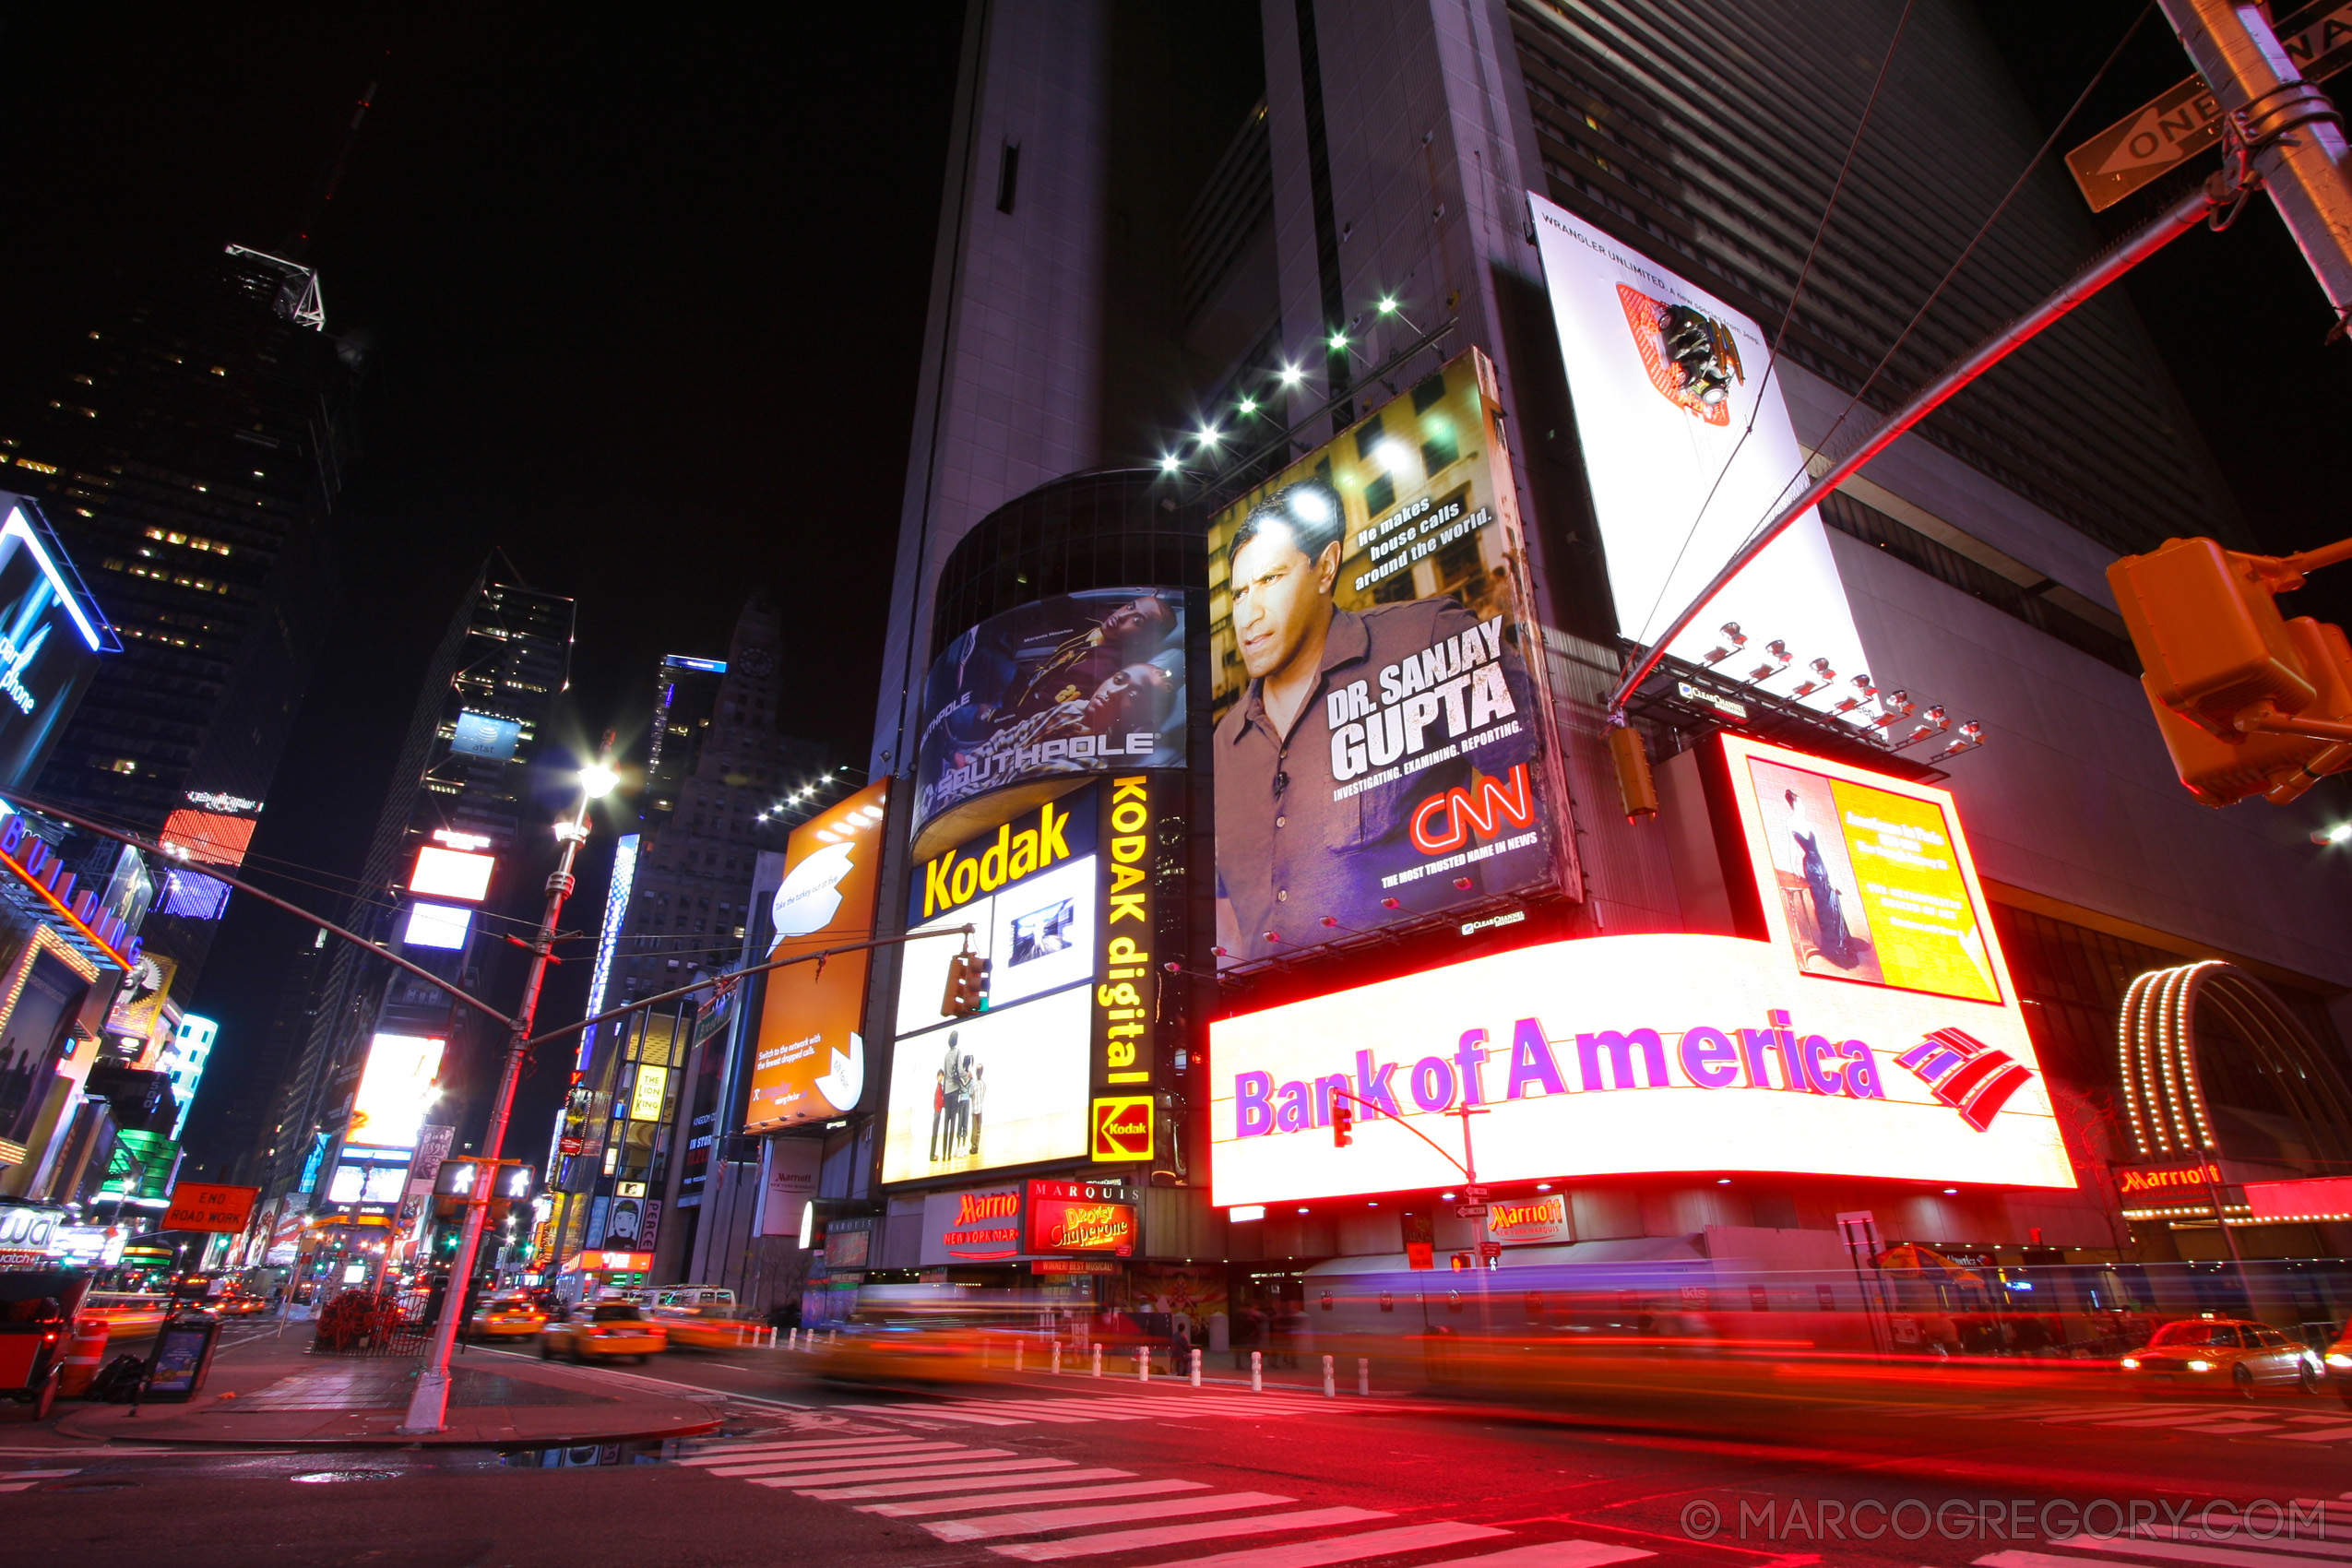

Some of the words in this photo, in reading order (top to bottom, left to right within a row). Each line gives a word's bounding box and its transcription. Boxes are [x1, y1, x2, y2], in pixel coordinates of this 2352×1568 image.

[2129, 94, 2220, 160] ONE
[1541, 212, 1607, 256] WRANGLER
[1609, 250, 1668, 291] UNLIMITED.
[1677, 292, 1693, 306] new
[1694, 303, 1722, 322] species
[1358, 529, 1377, 548] He
[1380, 497, 1430, 535] makes
[1370, 527, 1417, 562] house
[1420, 503, 1460, 534] calls
[1355, 552, 1408, 591] around
[1410, 537, 1437, 561] the
[1439, 507, 1492, 545] world.
[1326, 679, 1377, 731] DR.
[1379, 615, 1503, 706] SANJAY
[1330, 660, 1516, 782] GUPTA
[937, 733, 1154, 801] SOUTHPOLE
[1333, 766, 1403, 802] INVESTIGATING.
[1403, 744, 1460, 778] EXAMINING.
[1461, 720, 1523, 754] REPORTING.
[1409, 763, 1535, 856] CNN
[923, 802, 1071, 919] Kodak
[1110, 775, 1148, 925] KODAK
[1382, 876, 1398, 888] THE
[1398, 867, 1424, 884] MOST
[1424, 853, 1467, 874] TRUSTED
[1467, 844, 1494, 863] NAME
[1495, 841, 1507, 855] IN
[1507, 831, 1538, 852] NEWS
[1, 815, 143, 966] BUILDING
[1098, 936, 1148, 1084] digital
[757, 1062, 766, 1071] the
[765, 1057, 781, 1068] fewest
[781, 1049, 802, 1063] dropped
[758, 1048, 774, 1061] Switch
[779, 1044, 788, 1054] the
[788, 1037, 809, 1051] network
[809, 1033, 821, 1044] with
[645, 1075, 659, 1084] THE
[1234, 1048, 1403, 1140] Bank
[1410, 1028, 1491, 1113] of
[1506, 1008, 1887, 1100] America
[636, 1099, 659, 1111] KING
[638, 1085, 660, 1097] LION
[697, 1134, 712, 1148] STOR
[1109, 1122, 1147, 1135] Kodak
[775, 1172, 812, 1182] Marriott
[1035, 1183, 1139, 1199] MARQUIS
[2121, 1165, 2221, 1193] Marriott
[199, 1192, 226, 1205] END
[338, 1206, 385, 1214] Pasonic
[953, 1194, 1020, 1227] Marrio
[1489, 1198, 1562, 1231] Marriott
[170, 1209, 204, 1222] ROAD
[208, 1212, 241, 1224] WORK
[641, 1201, 659, 1247] PEACE
[1528, 1225, 1560, 1234] MARQUIS
[944, 1232, 964, 1244] NEW
[966, 1230, 992, 1243] YORK
[1051, 1219, 1129, 1248] Chaperone
[1042, 1261, 1069, 1271] WINNER!
[1070, 1261, 1085, 1271] BEST
[1085, 1261, 1113, 1272] MUSICAL!
